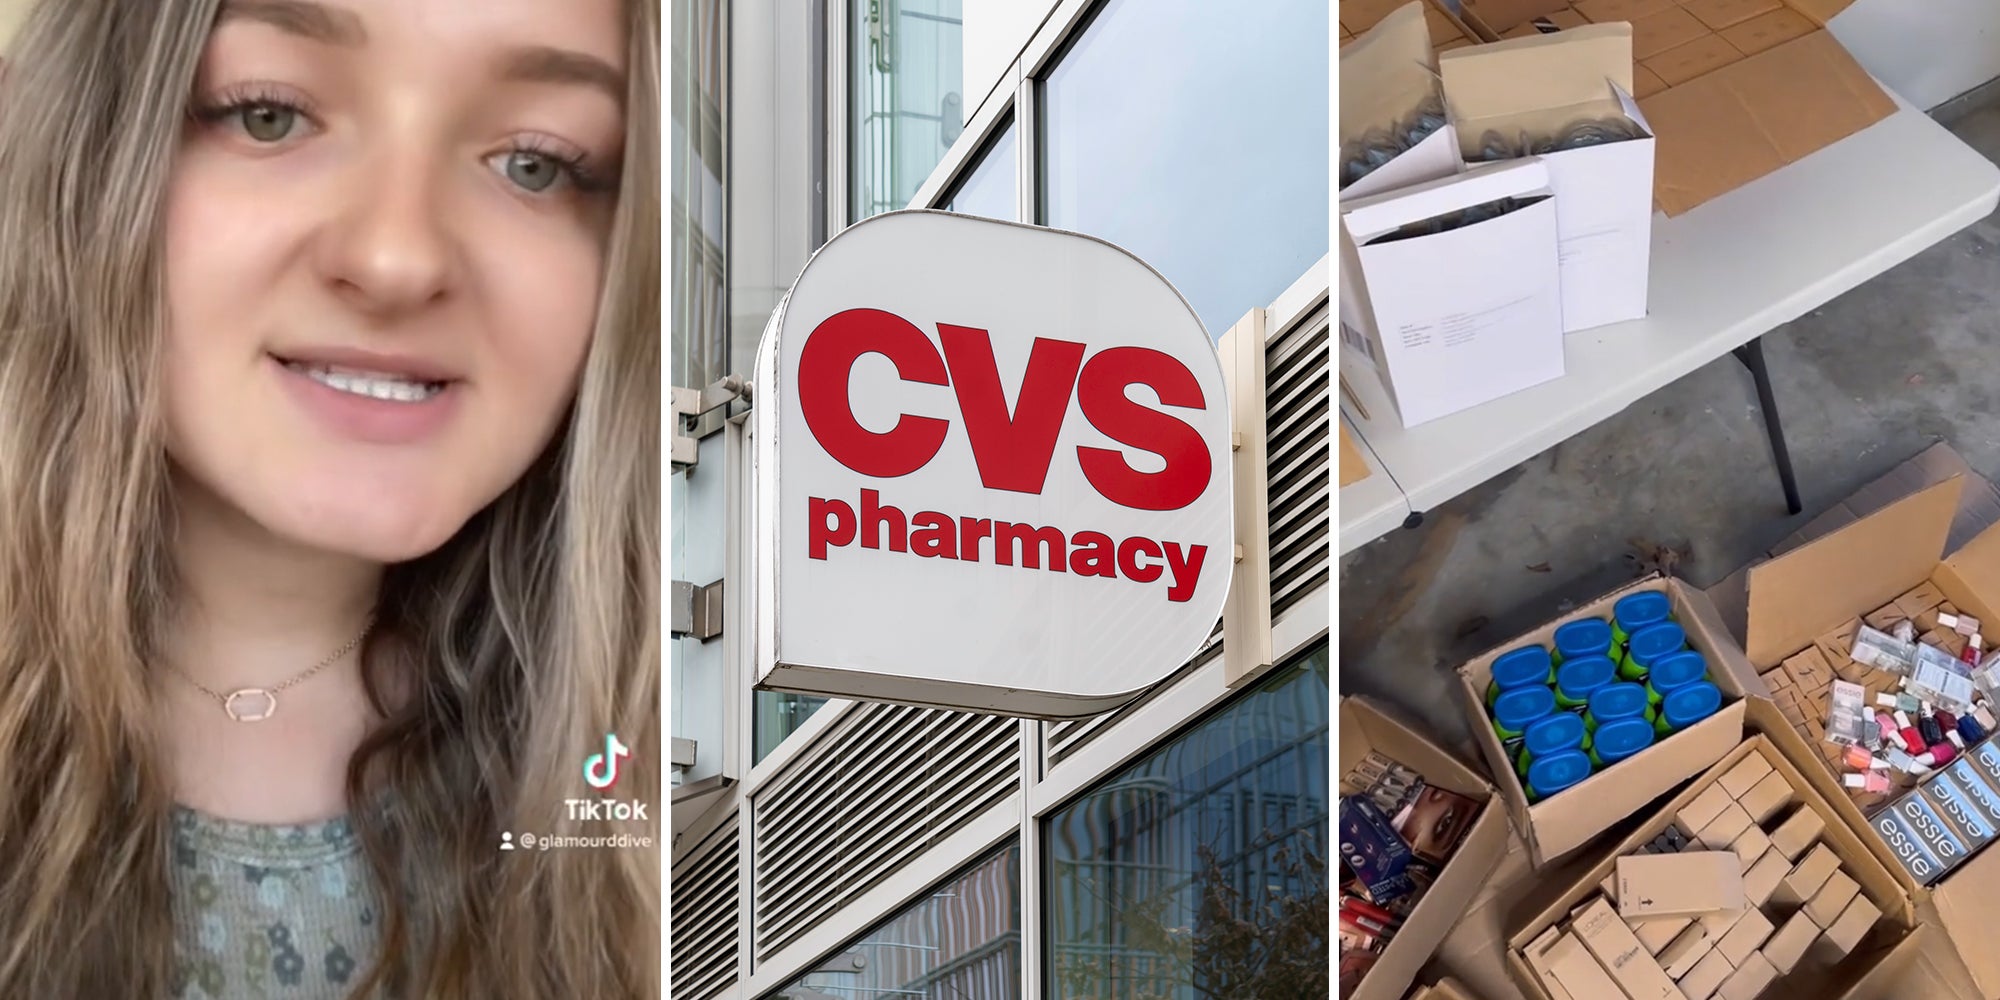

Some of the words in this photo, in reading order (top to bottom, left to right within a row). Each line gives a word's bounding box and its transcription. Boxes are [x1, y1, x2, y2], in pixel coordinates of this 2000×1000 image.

[798, 308, 1212, 511] CVS
[808, 487, 1208, 602] pharmacy
[1905, 801, 1956, 857] essie
[1933, 783, 1983, 837] essie
[1880, 818, 1930, 876] essie
